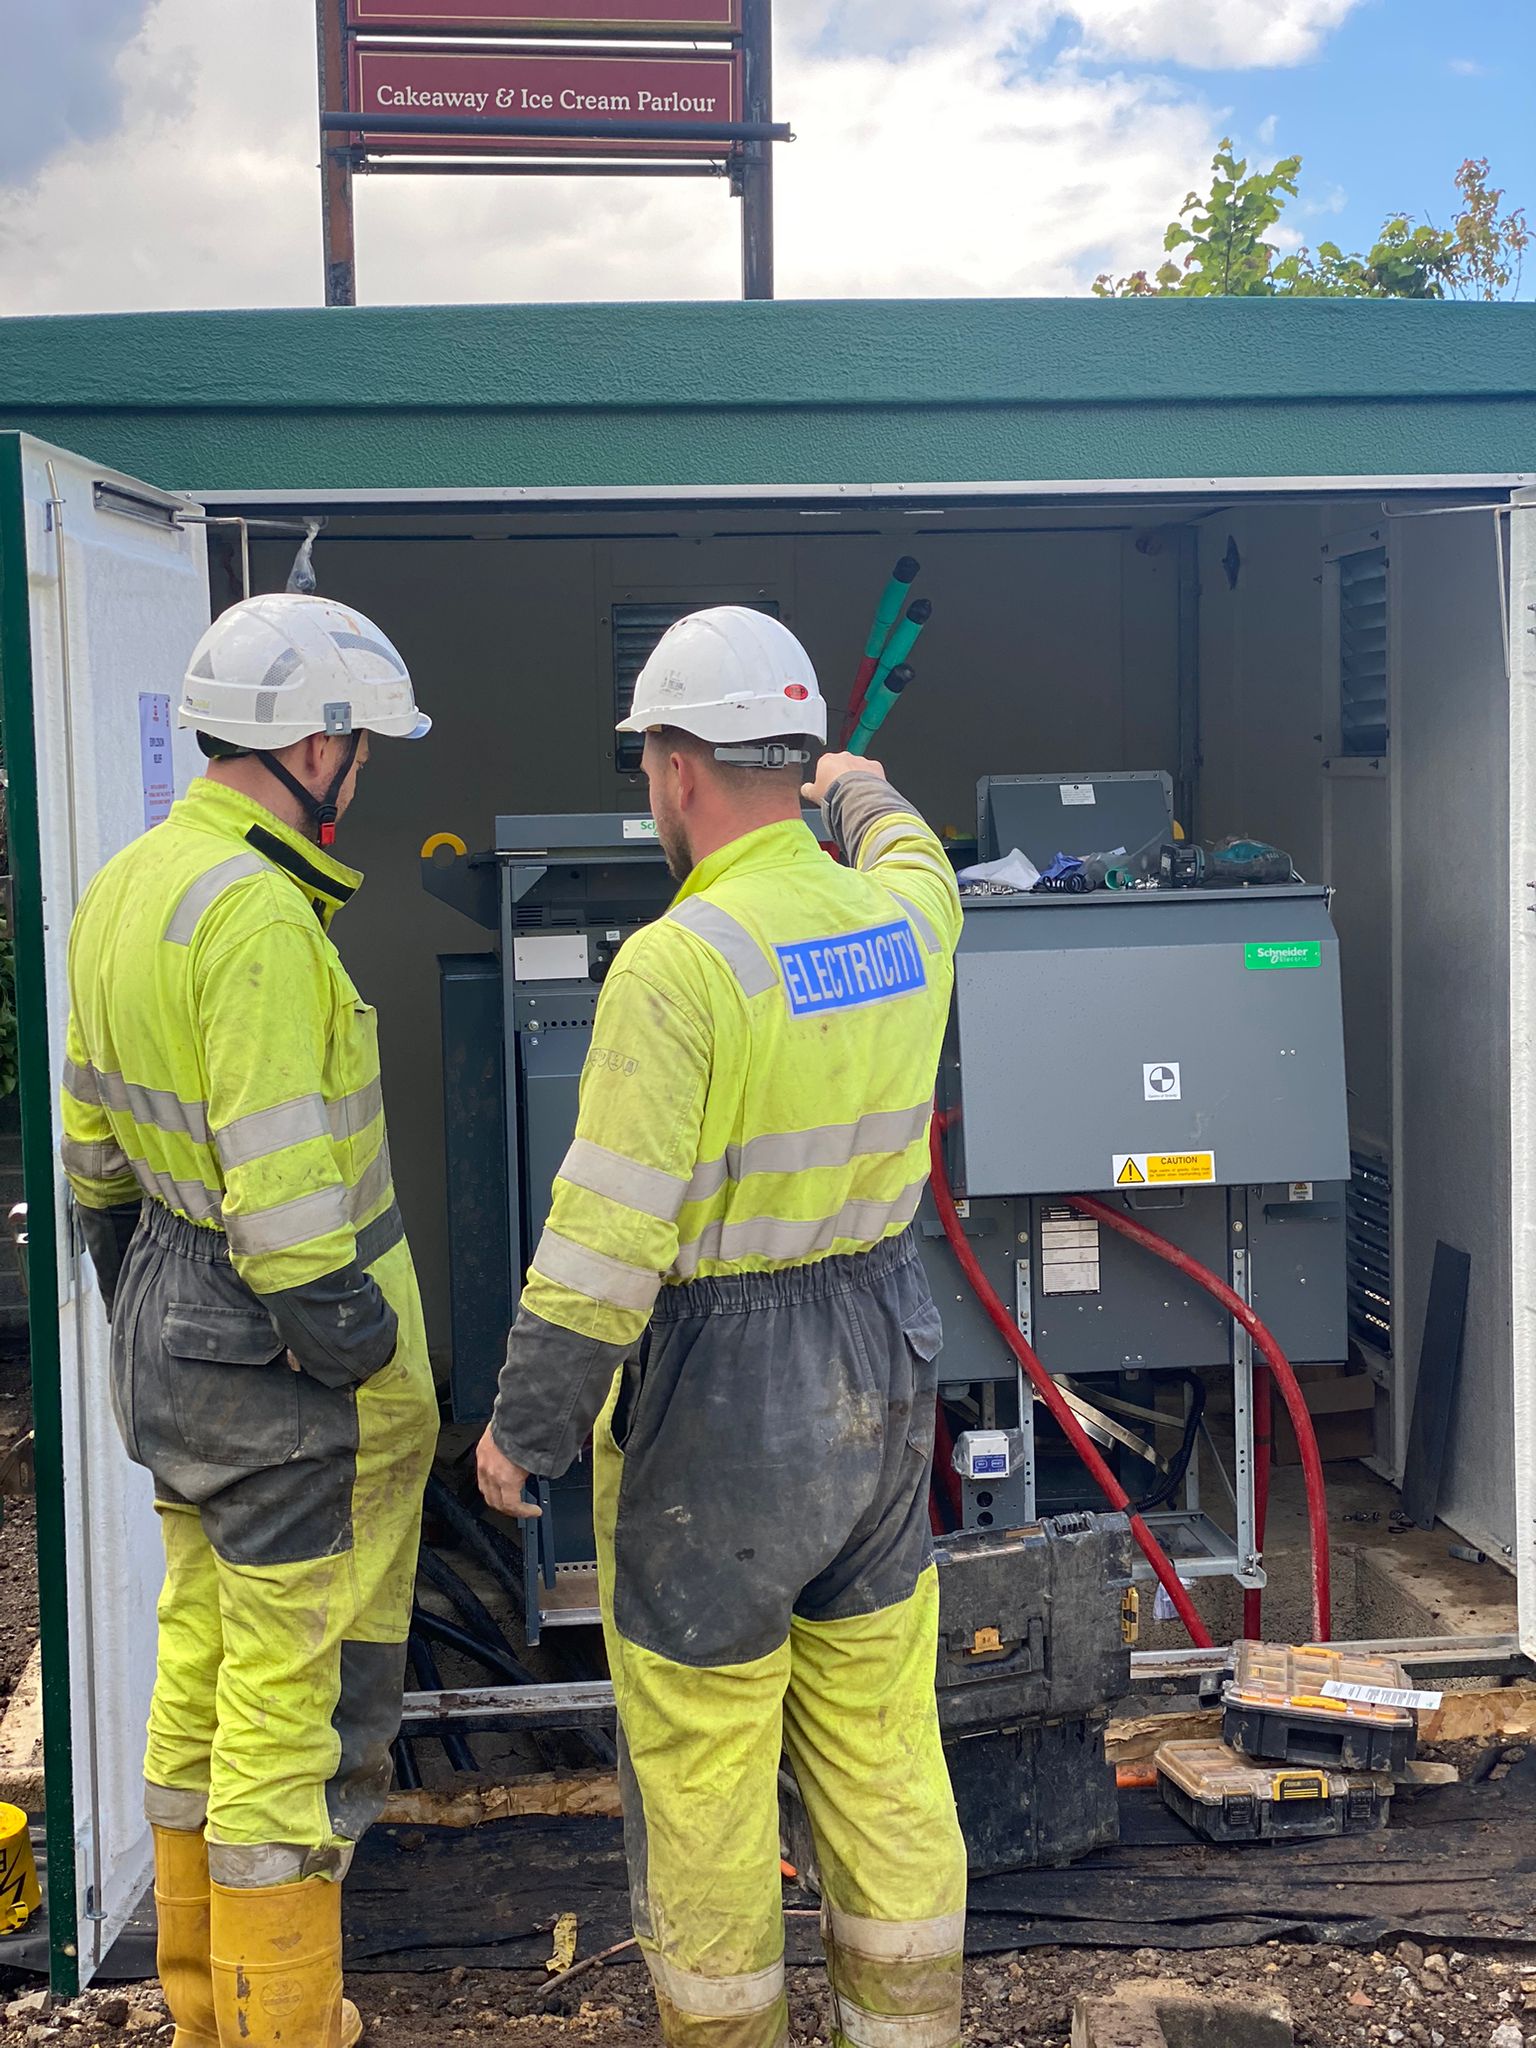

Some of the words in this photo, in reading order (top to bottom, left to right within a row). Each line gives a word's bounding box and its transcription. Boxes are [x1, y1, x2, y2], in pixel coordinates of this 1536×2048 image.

[377, 85, 489, 111] Cakeaway
[495, 88, 516, 108] &
[520, 89, 553, 109] Ice
[559, 89, 631, 111] Cream
[637, 91, 716, 112] Parlour
[1257, 947, 1309, 957] Schneider
[781, 929, 920, 1005] ELECTRICITY
[1160, 1156, 1198, 1165] CAUTION
